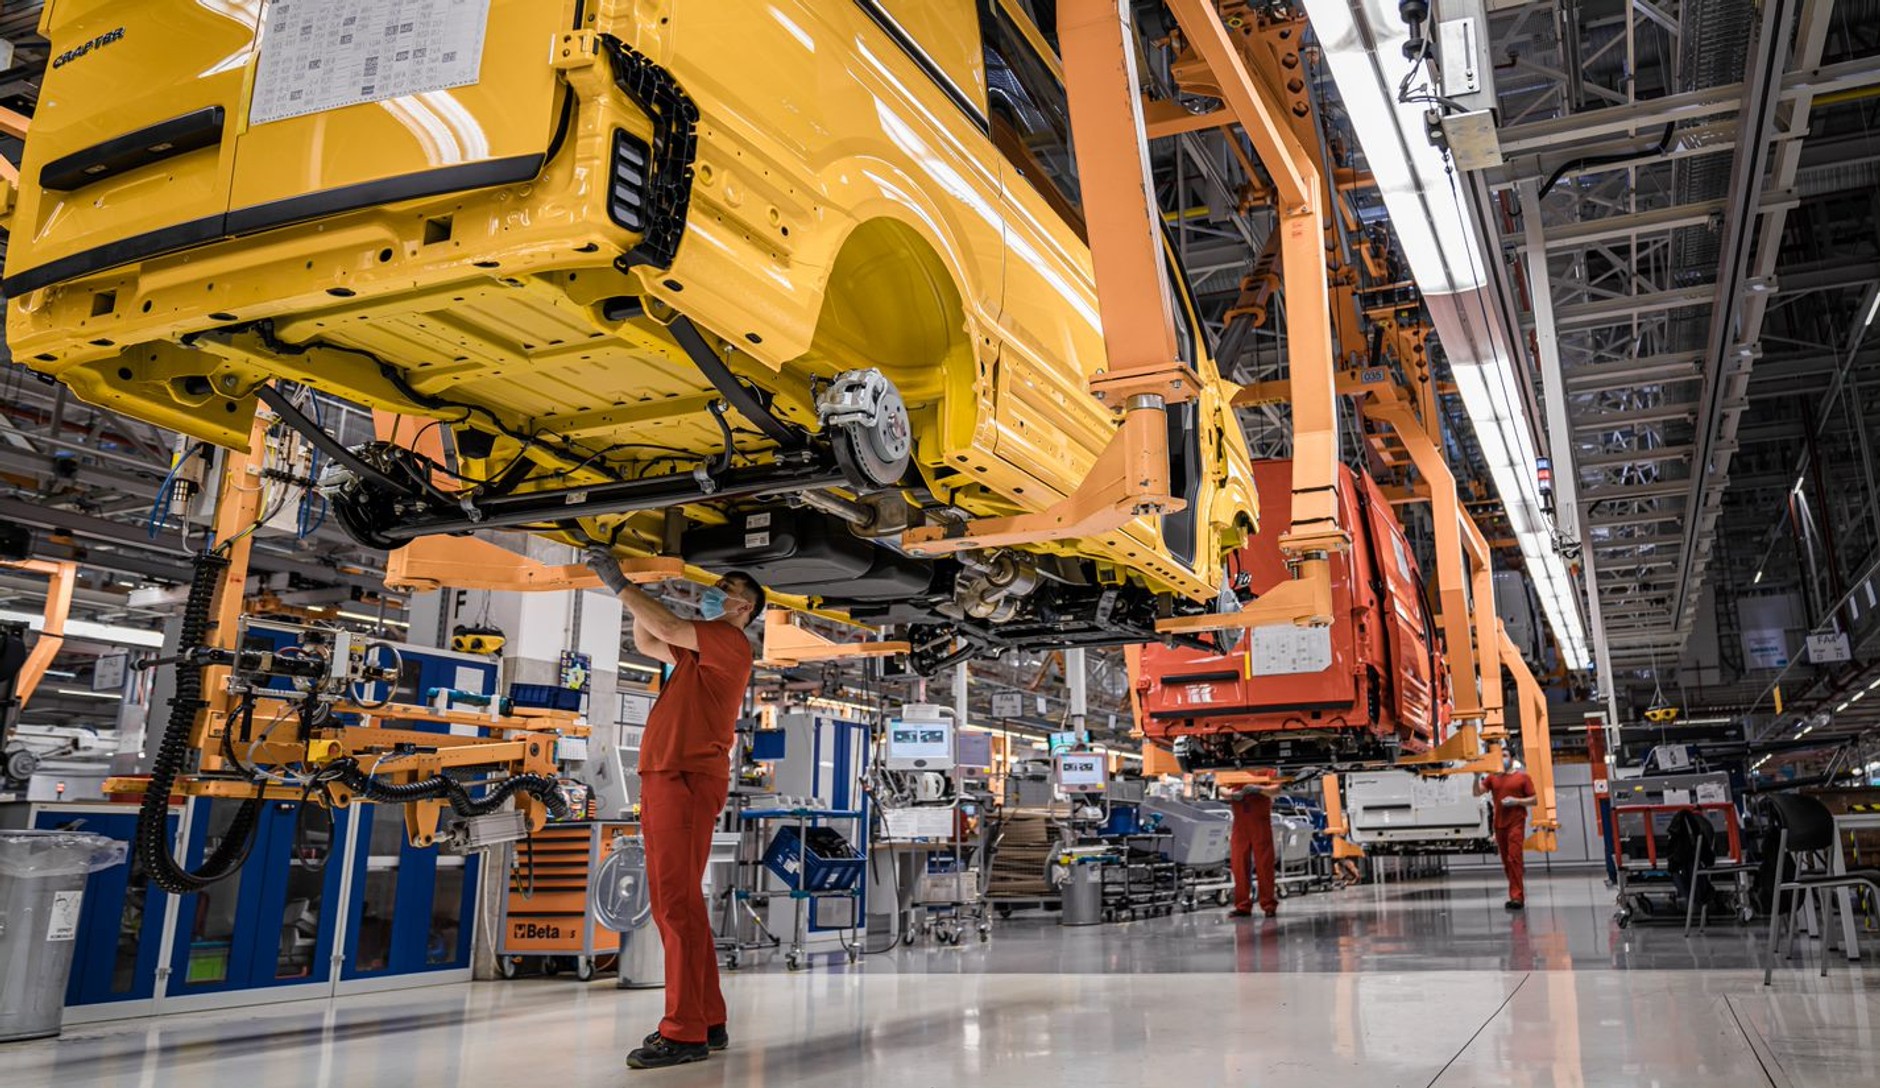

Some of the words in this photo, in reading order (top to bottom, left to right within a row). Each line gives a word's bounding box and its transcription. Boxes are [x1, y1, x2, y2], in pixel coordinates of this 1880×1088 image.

[52, 26, 126, 69] CRAFTER
[454, 589, 467, 619] F
[526, 923, 560, 939] Beta
